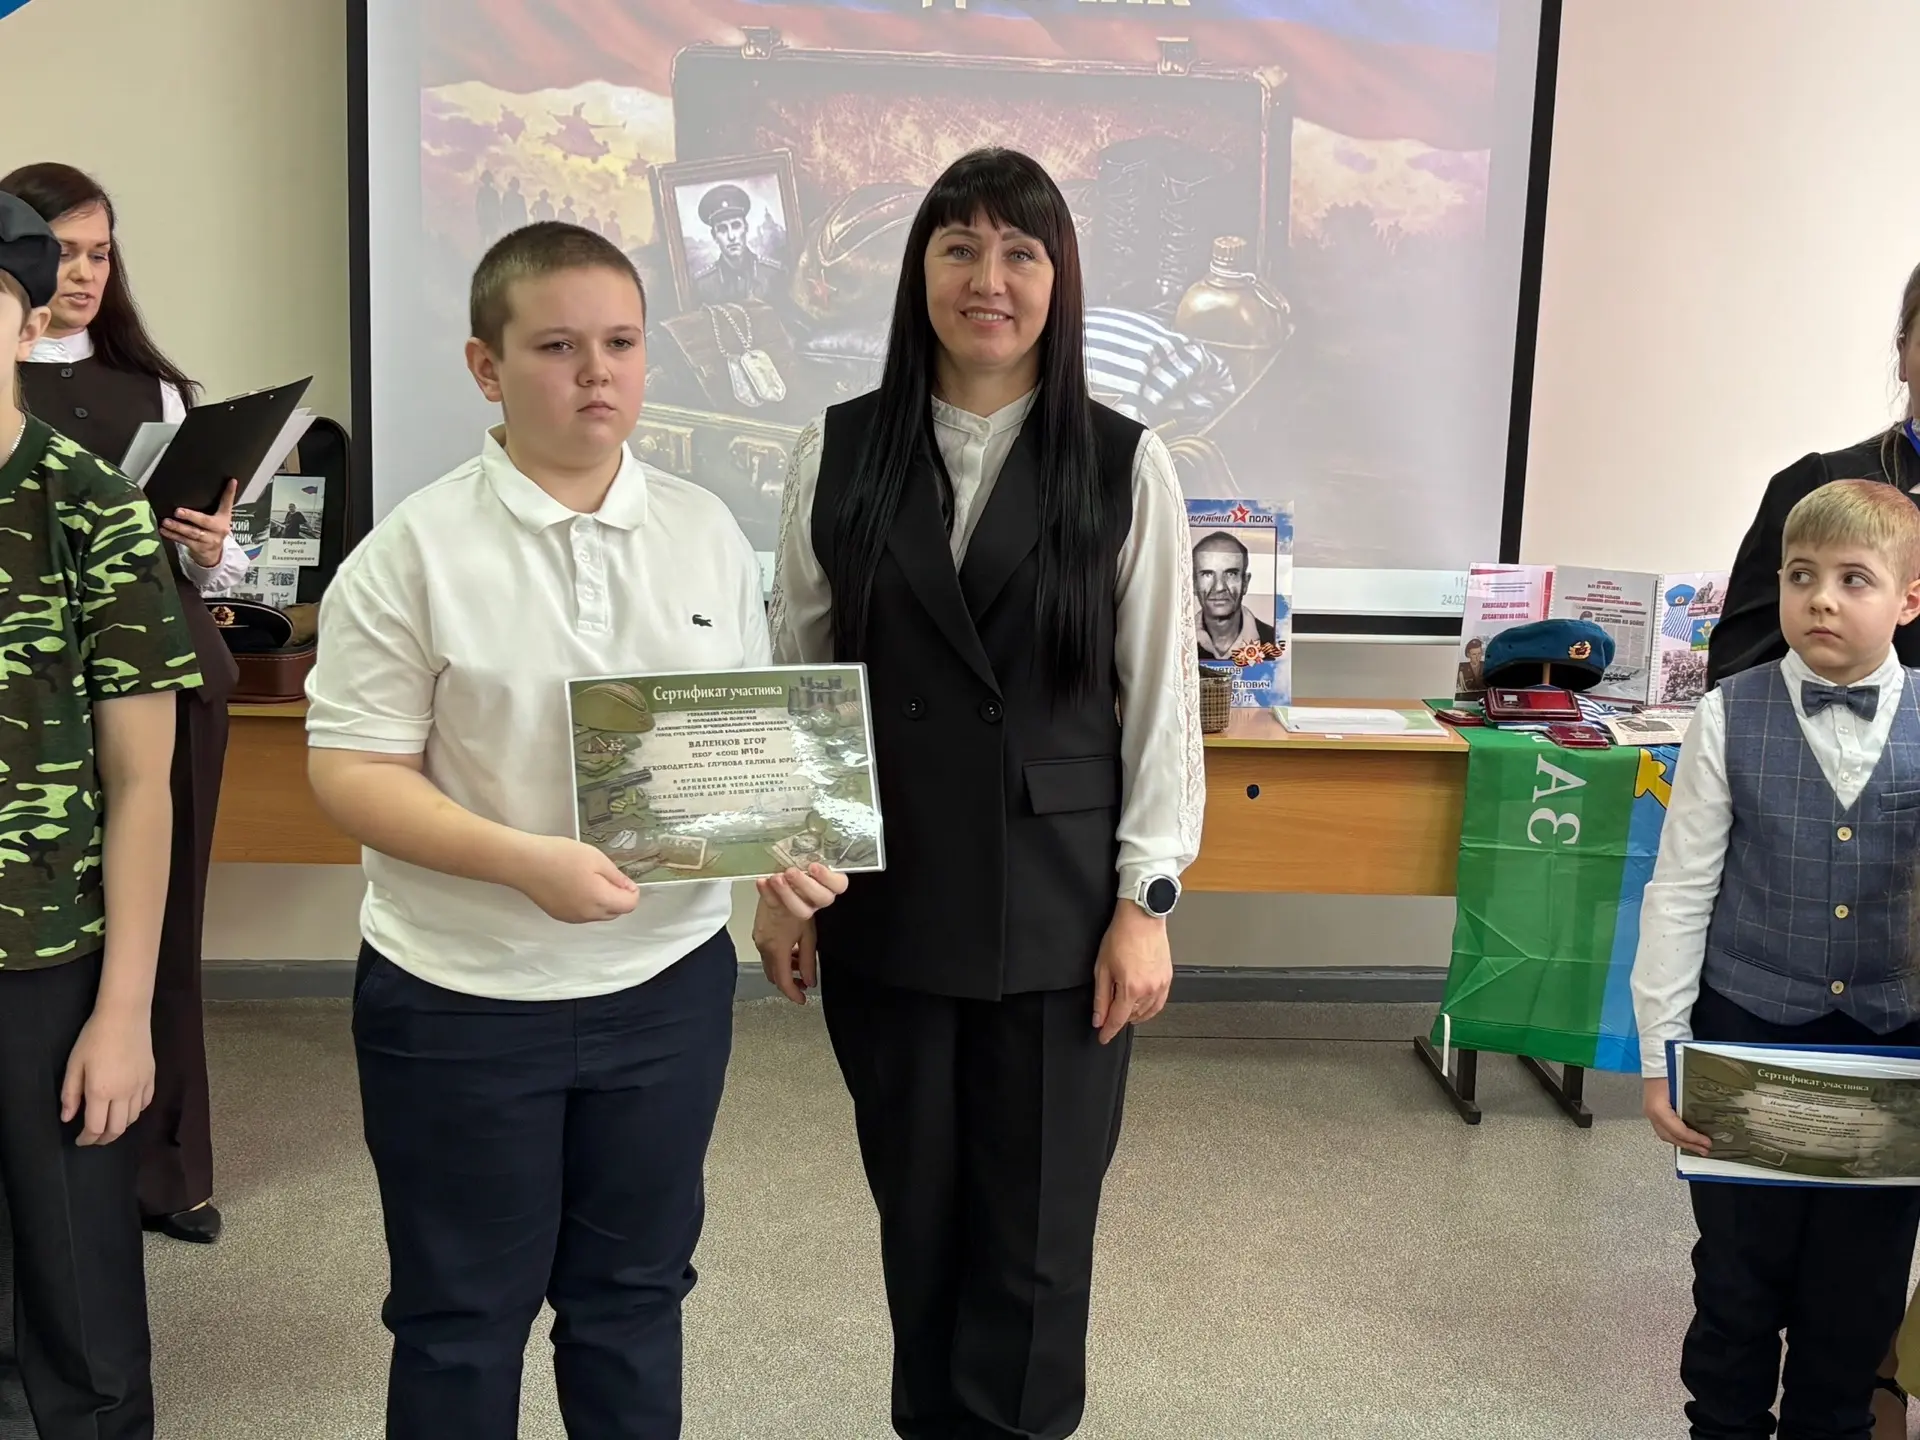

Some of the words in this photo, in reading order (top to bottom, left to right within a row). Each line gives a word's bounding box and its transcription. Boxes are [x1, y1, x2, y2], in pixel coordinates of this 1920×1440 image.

[1249, 515, 1273, 523] ПОЛК
[230, 519, 250, 531] КИЙ
[1233, 681, 1270, 689] влович
[652, 684, 727, 704] Сертификат
[730, 685, 783, 700] участника
[688, 738, 740, 748] ВАЛЕНКОВ
[743, 737, 767, 746] ЕГОР
[745, 758, 776, 767] ГАЛИНА
[1757, 1068, 1821, 1086] Сертификат
[1821, 1081, 1869, 1092] участника
